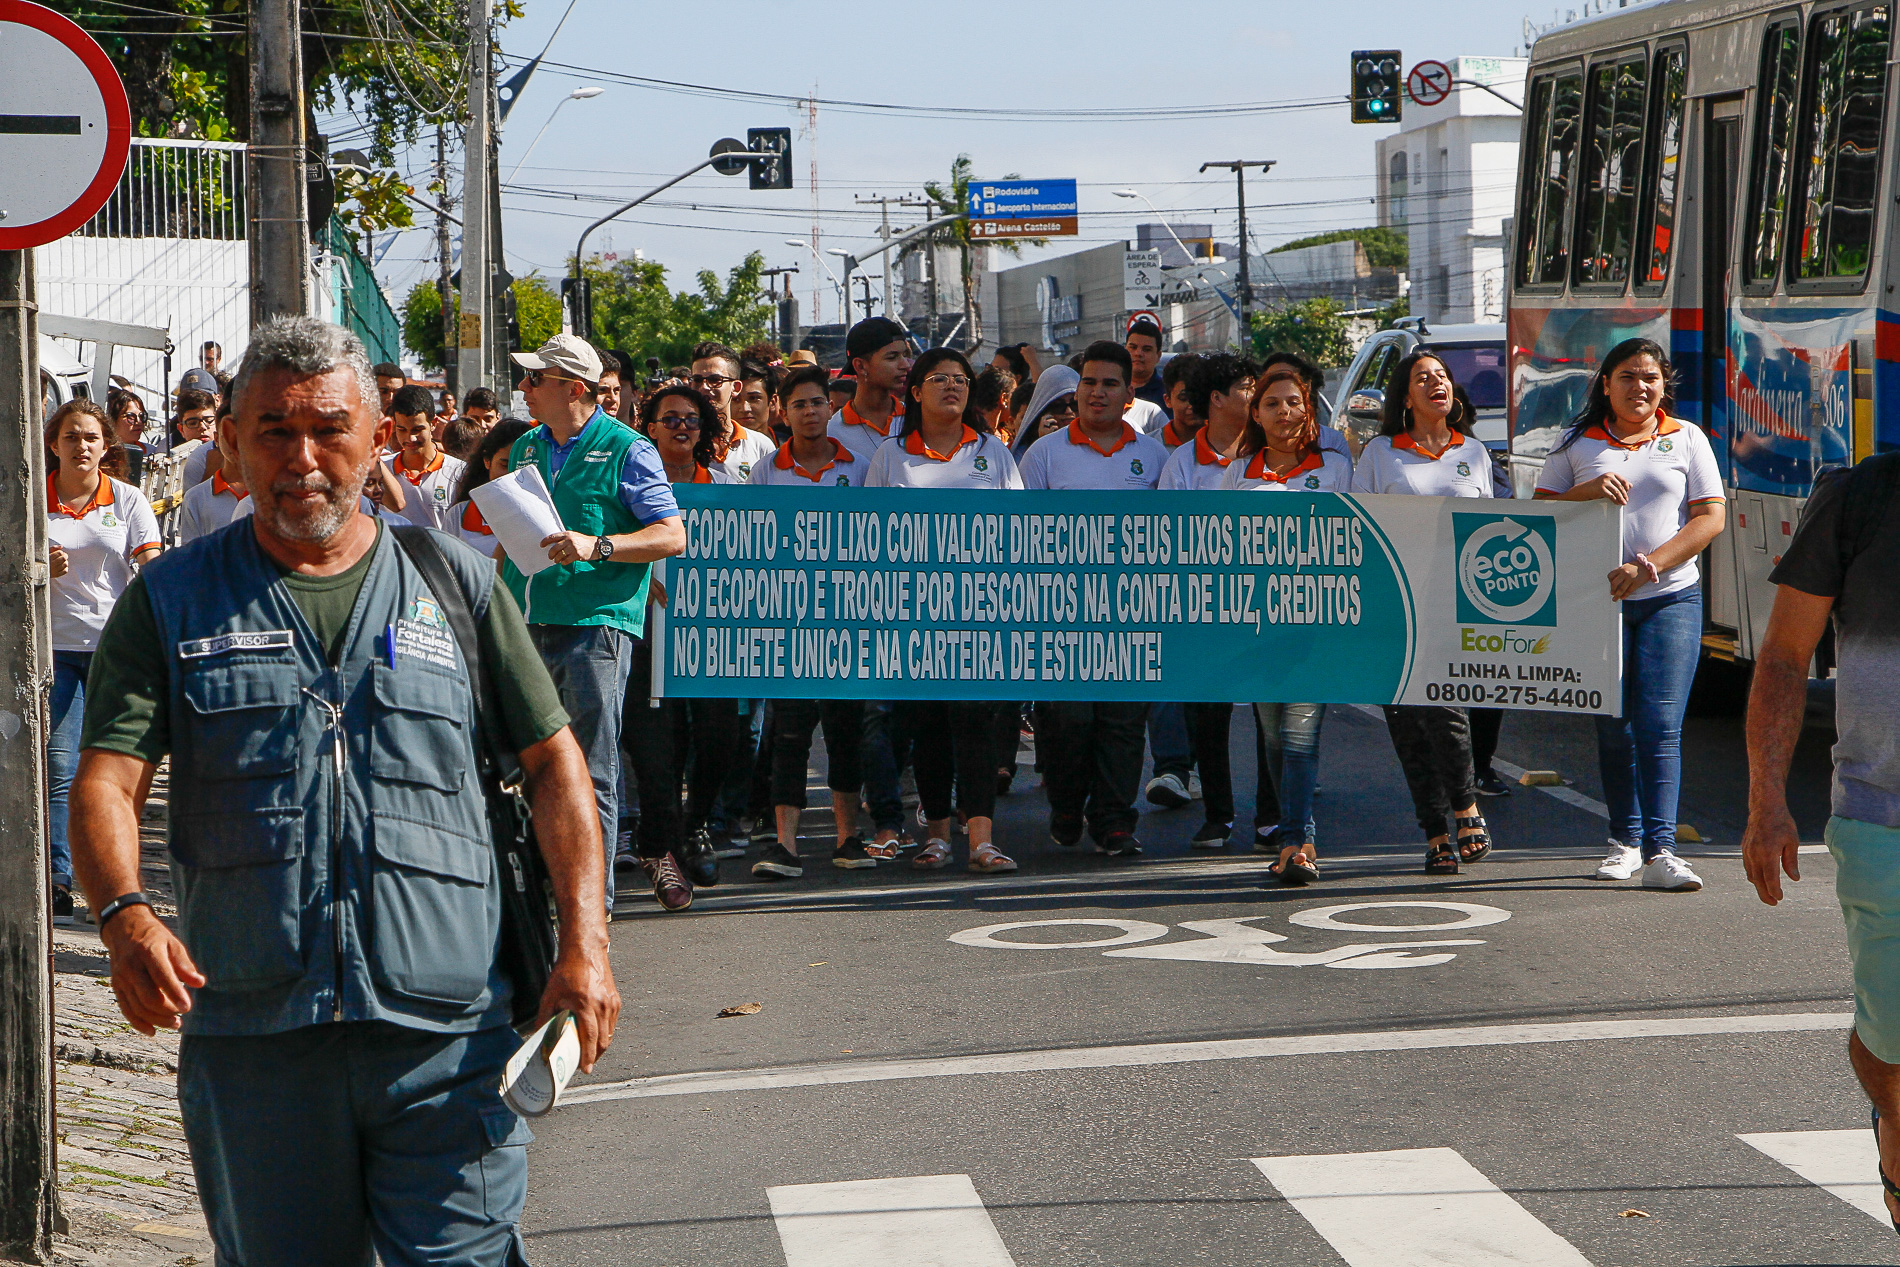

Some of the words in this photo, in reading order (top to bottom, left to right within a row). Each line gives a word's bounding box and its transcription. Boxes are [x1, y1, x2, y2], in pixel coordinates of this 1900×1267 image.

[995, 187, 1039, 196] Rodoviária
[996, 204, 1031, 213] Aeroporto
[1032, 202, 1076, 211] Internacional
[997, 223, 1022, 232] Arena
[1024, 222, 1061, 232] Castelão
[1127, 261, 1157, 269] ESPERA
[782, 536, 789, 548] -
[793, 510, 831, 562] SEU
[837, 511, 881, 563] LIXO
[886, 512, 929, 563] COM
[934, 513, 1004, 564] VALOR!
[1010, 514, 1115, 565] DIRECIONE
[1121, 514, 1172, 566] SEUS
[1177, 514, 1233, 566] LIXOS
[1239, 503, 1364, 568] RECICLÁVEIS
[1473, 545, 1532, 580] eco
[1484, 570, 1541, 595] PONTO
[673, 567, 700, 619] AO
[705, 568, 808, 620] ECOPONTO
[814, 570, 826, 619] E
[831, 570, 910, 624] TROQUE
[916, 571, 955, 622] POR
[961, 572, 1078, 623] DESCONTOS
[1083, 573, 1111, 623] NA
[1116, 573, 1182, 624] CONTA
[1188, 573, 1213, 624] DE
[1219, 573, 1261, 636] LUZ,
[1266, 561, 1362, 625] CRÉDITOS
[397, 618, 443, 638] Prefeitura
[201, 635, 270, 652] SUPERVISOR
[397, 627, 454, 653] Fortaleza
[673, 626, 699, 678] NO
[705, 627, 785, 678] BILHETE
[791, 618, 851, 679] ÚNICO
[858, 629, 870, 679] E
[875, 629, 902, 680] NA
[908, 629, 1005, 681] CARTEIRA
[1010, 630, 1036, 681] DE
[1041, 630, 1162, 682] ESTUDANTE!
[1461, 627, 1537, 654] EcoFor
[394, 645, 426, 661] IGILÂNCIA
[1448, 662, 1512, 681] LINHA
[1517, 665, 1582, 684] LIMPA:
[1426, 682, 1603, 710] 0800-275-4400
